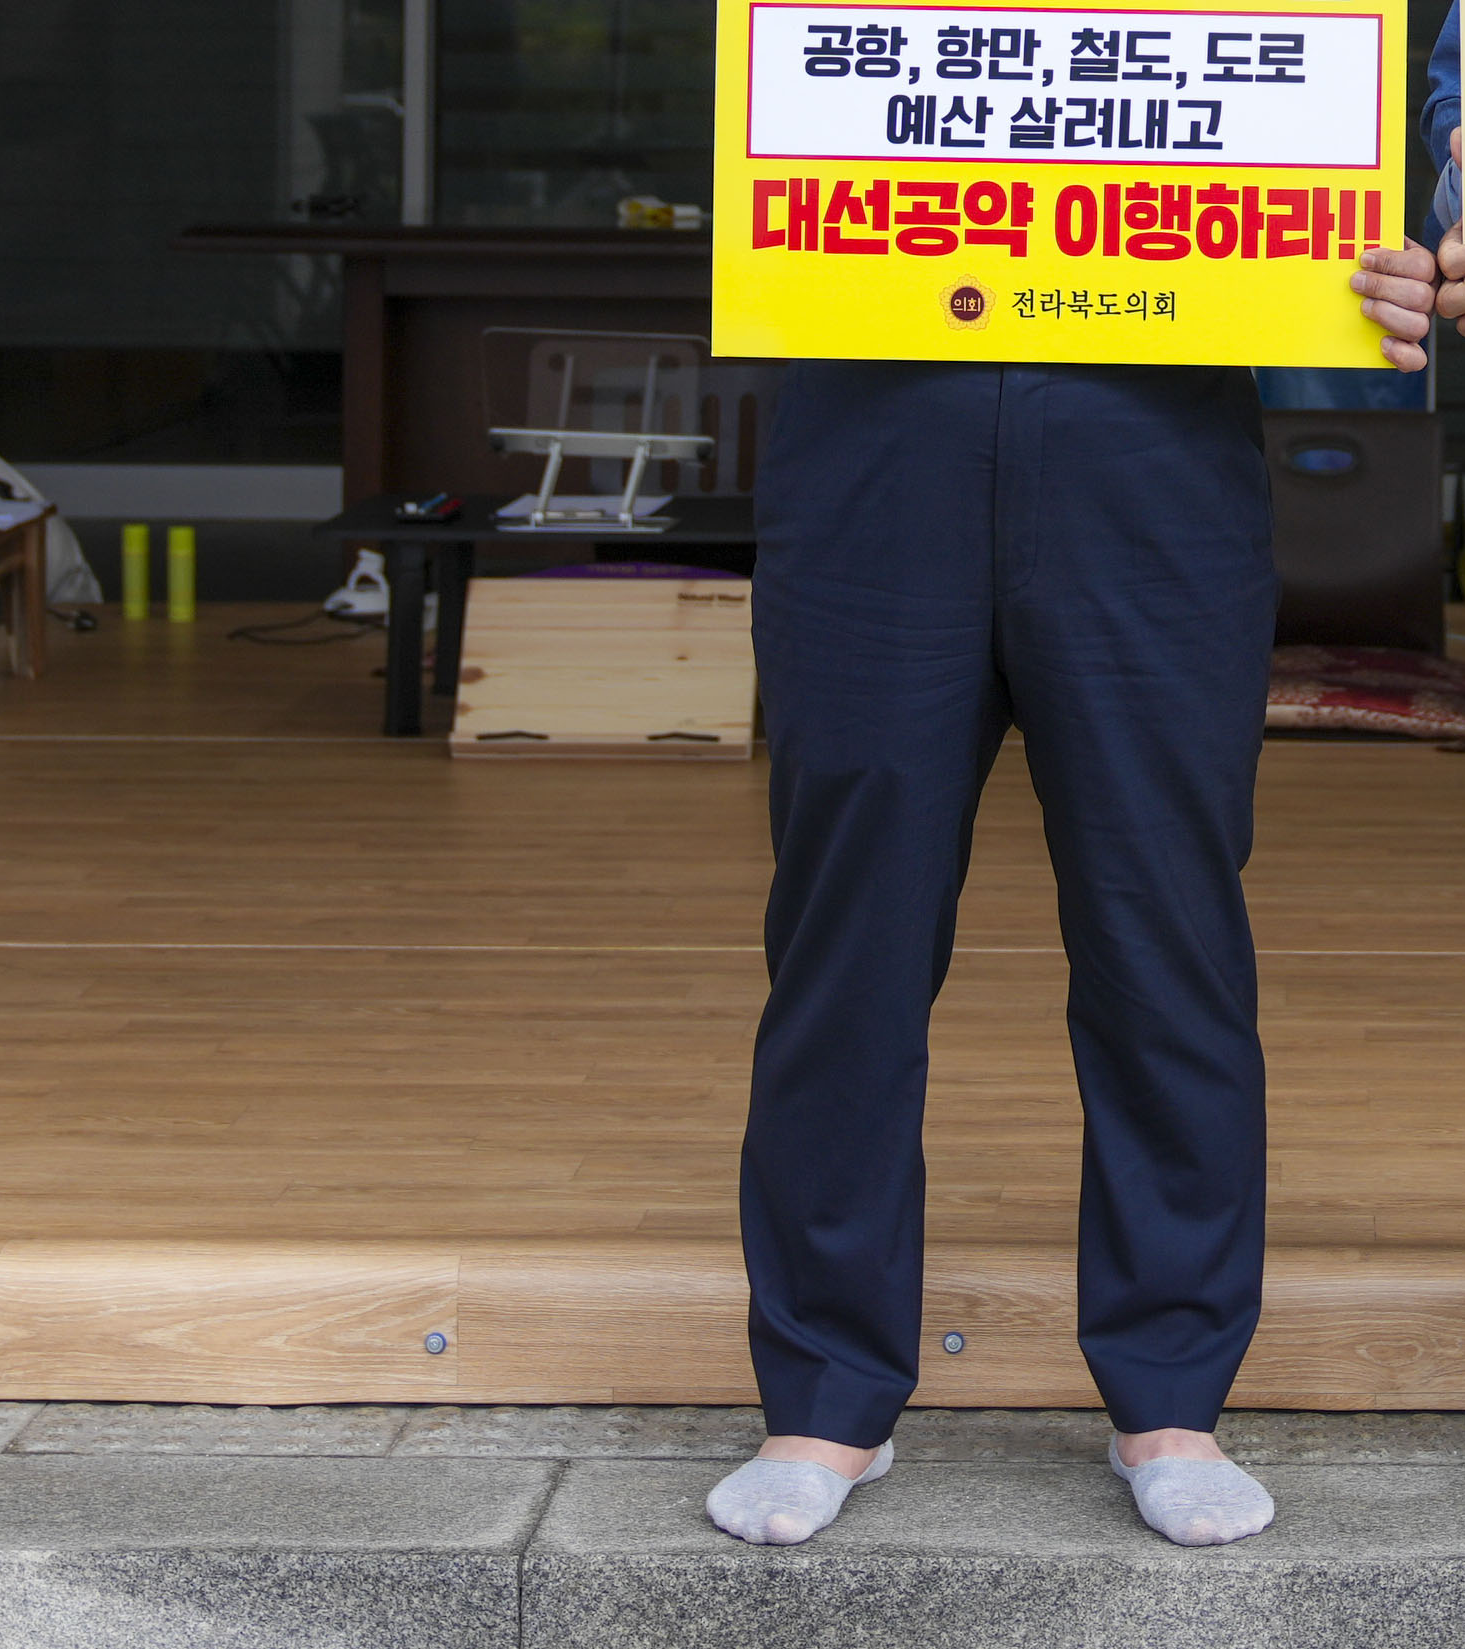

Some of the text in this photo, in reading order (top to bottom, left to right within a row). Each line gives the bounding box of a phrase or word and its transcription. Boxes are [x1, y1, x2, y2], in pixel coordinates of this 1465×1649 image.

[803, 24, 1306, 90] 공항, 항만, 철도, 도로
[886, 94, 1223, 150] 예산 살려내고
[752, 177, 1382, 261] 대선공약 이행하라!!
[952, 296, 981, 313] 의회
[1011, 288, 1177, 322] 전라북도의회
